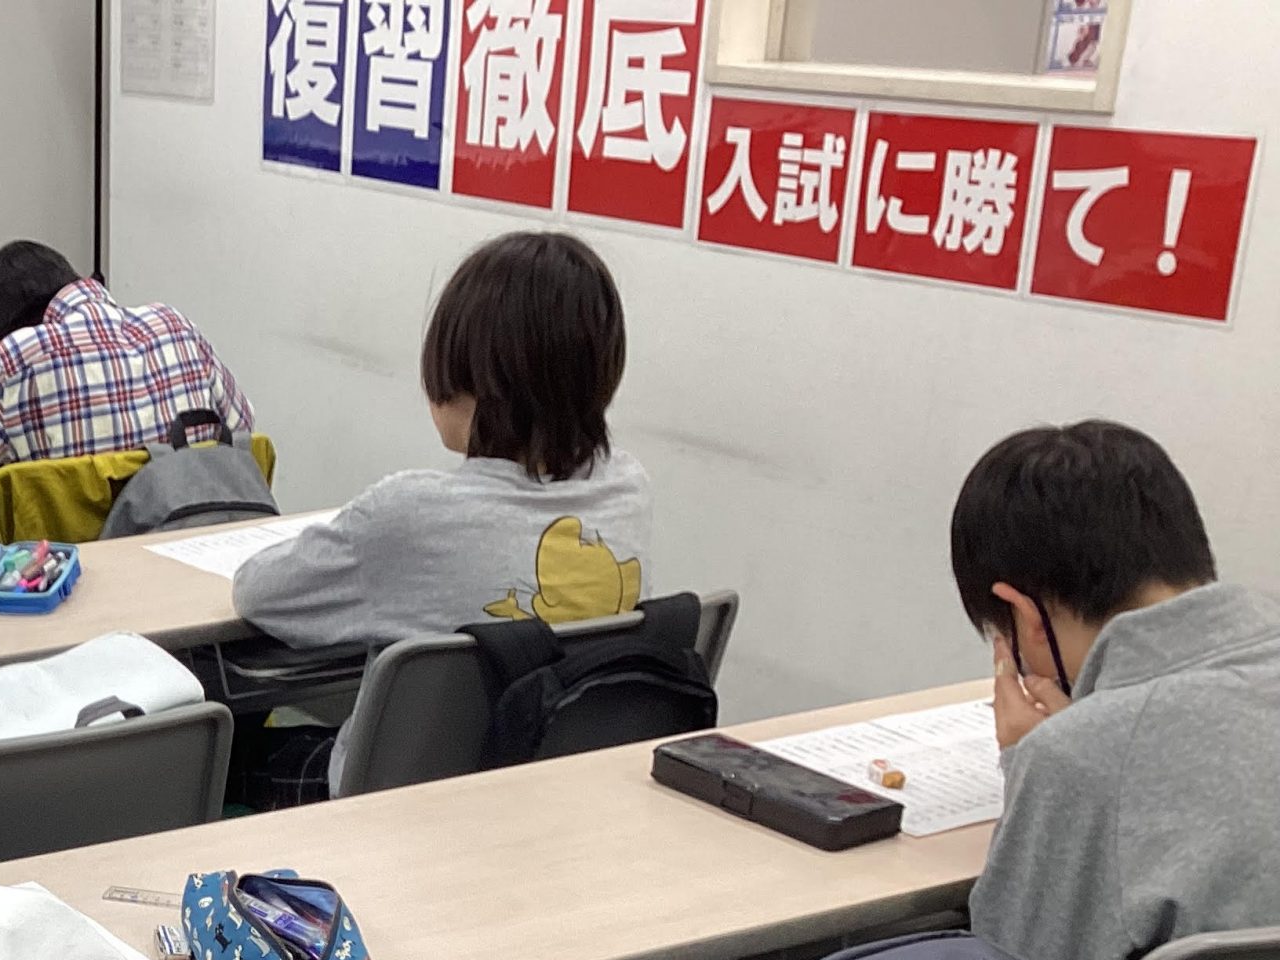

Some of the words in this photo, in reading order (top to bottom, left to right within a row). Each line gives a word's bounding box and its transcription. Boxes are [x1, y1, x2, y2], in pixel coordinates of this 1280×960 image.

[269, 0, 696, 172] 復習徹底
[707, 126, 1191, 276] 入試に勝て！
